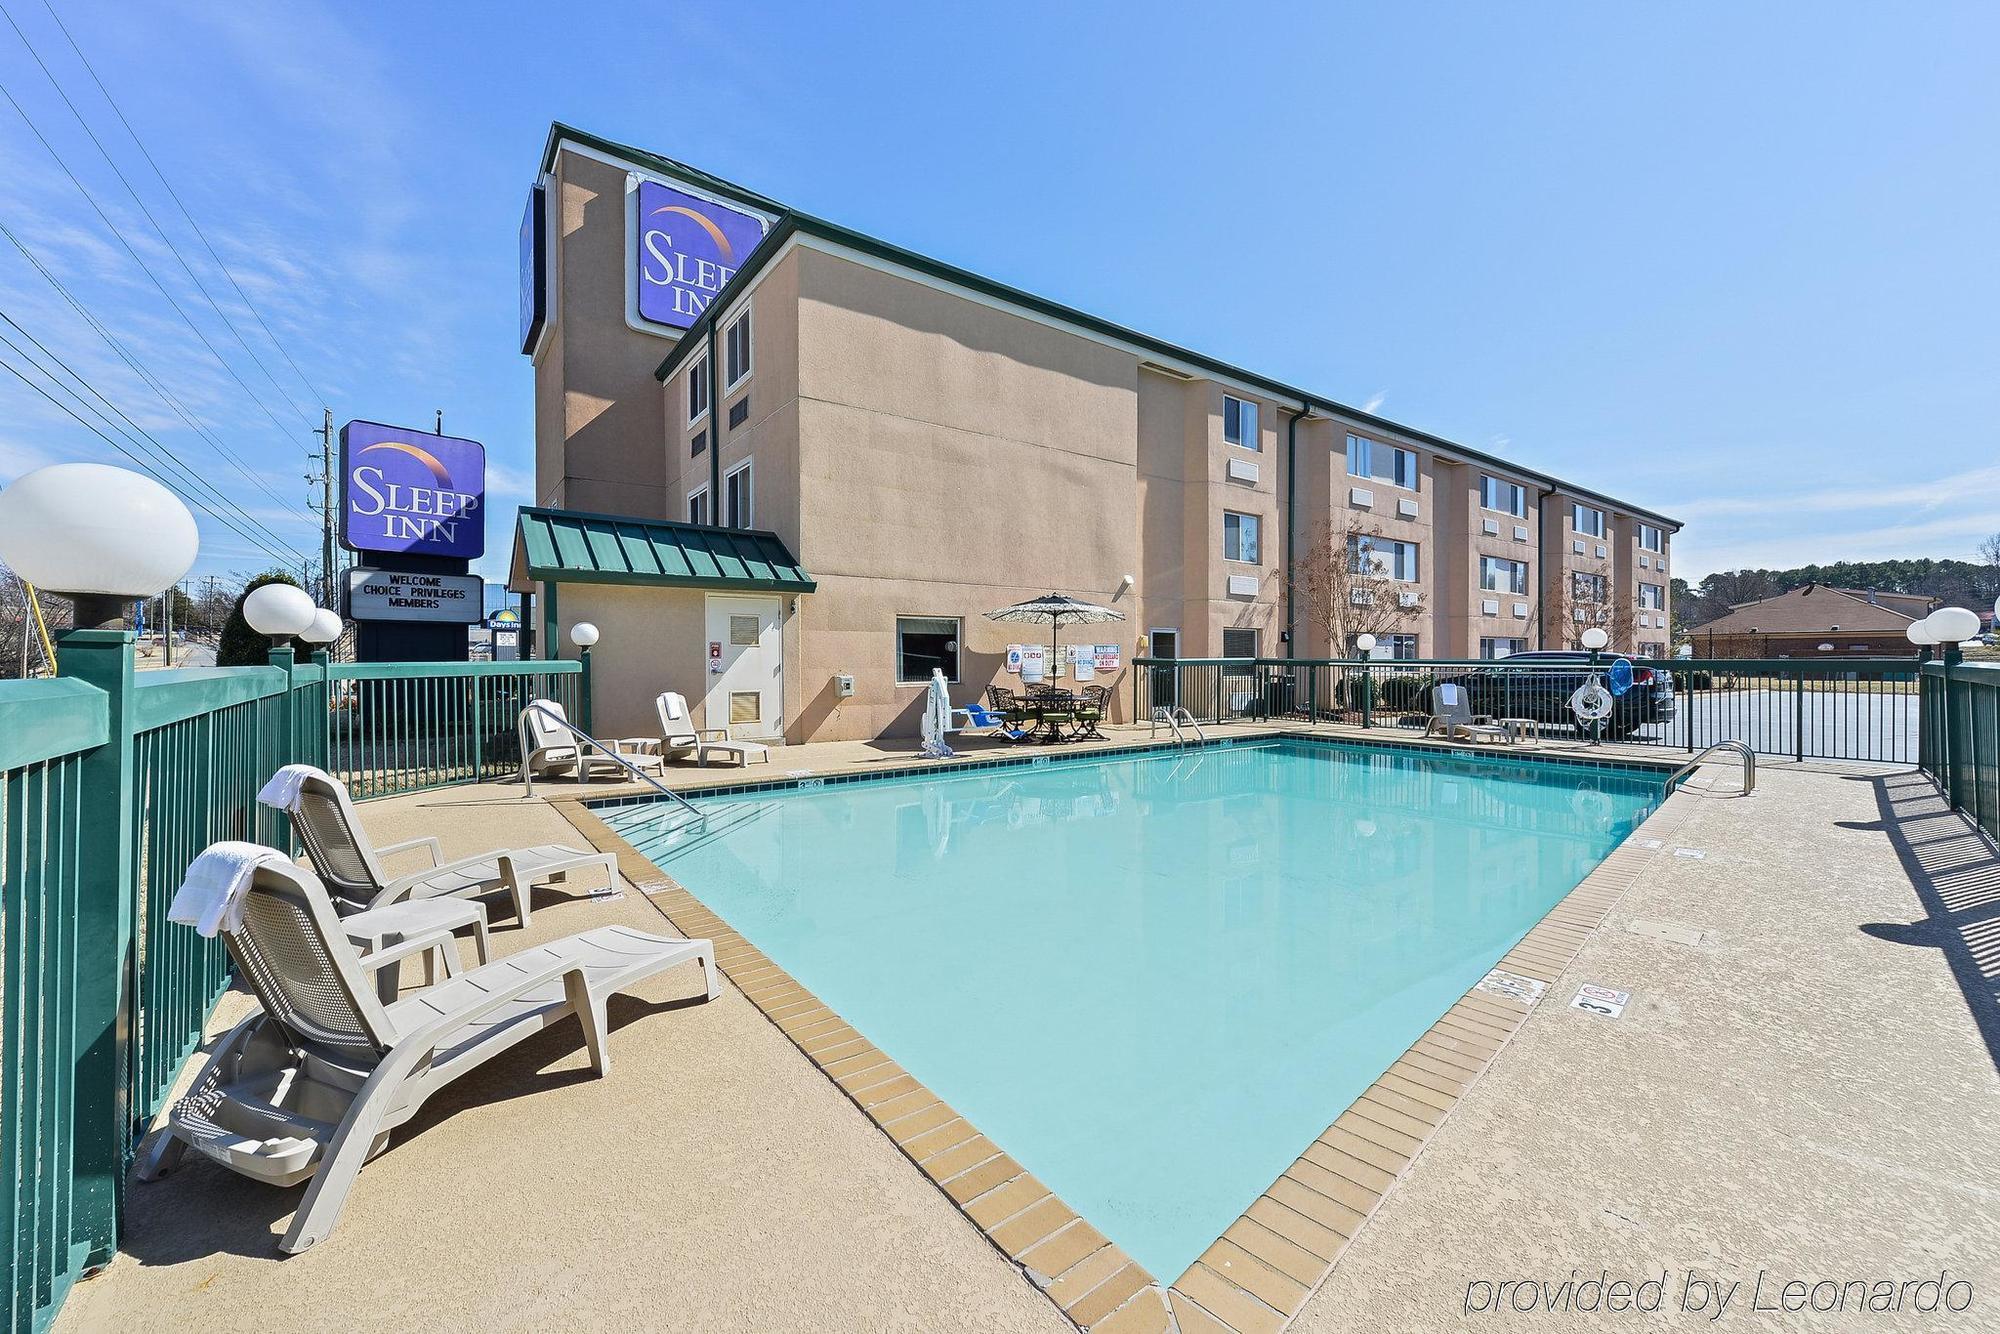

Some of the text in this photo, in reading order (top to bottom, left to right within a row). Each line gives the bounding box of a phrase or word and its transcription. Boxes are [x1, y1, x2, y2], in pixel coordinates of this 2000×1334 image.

[644, 230, 737, 293] SLEE
[671, 285, 713, 317] IN
[352, 466, 478, 520] SLEEP
[383, 514, 459, 544] INN
[363, 584, 466, 599] CHOICE PRIVILEGES
[389, 575, 441, 587] WELCOME
[388, 597, 440, 609] MEMBERS
[1579, 1002, 1612, 1014] 3
